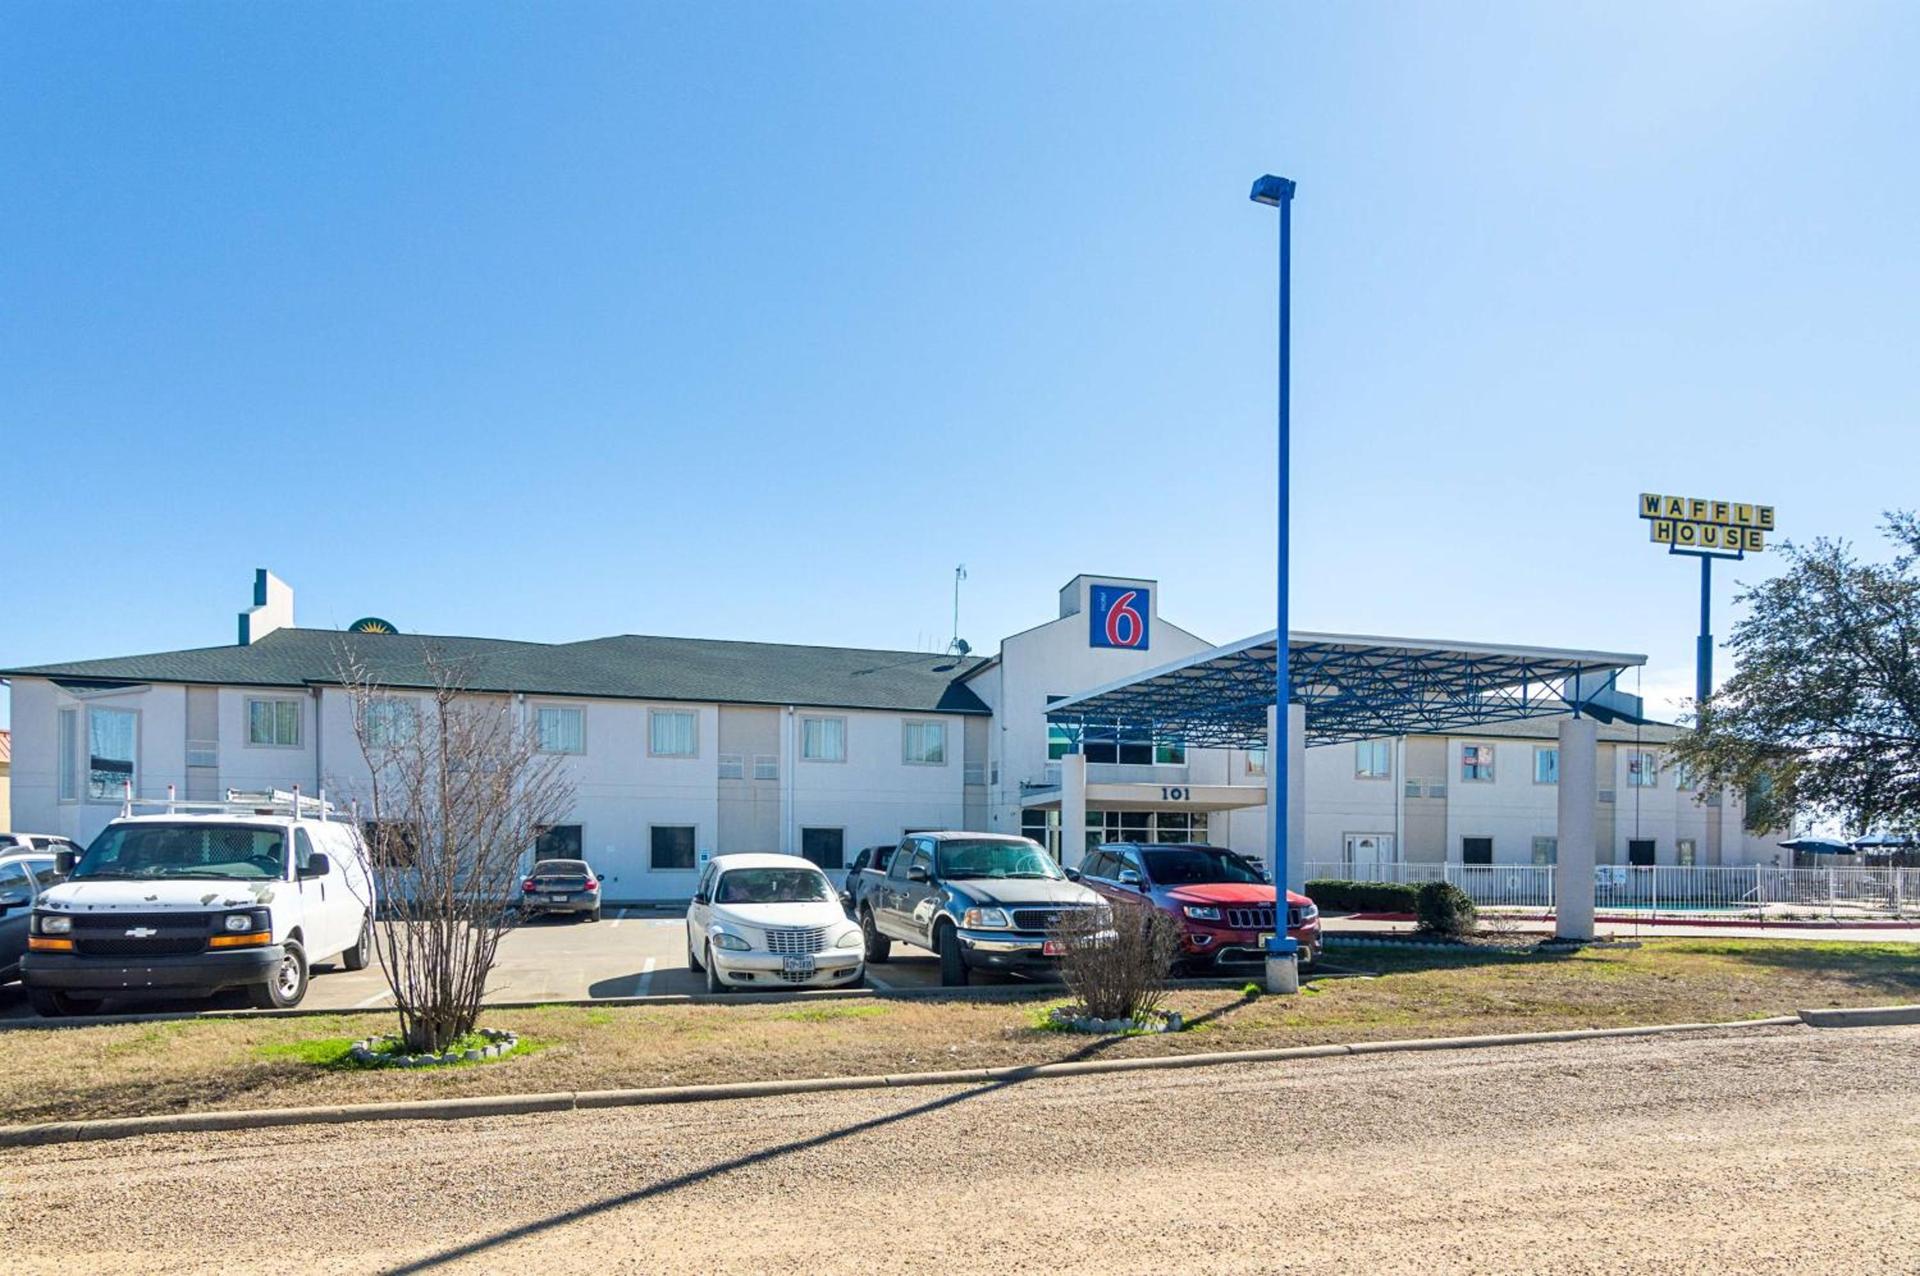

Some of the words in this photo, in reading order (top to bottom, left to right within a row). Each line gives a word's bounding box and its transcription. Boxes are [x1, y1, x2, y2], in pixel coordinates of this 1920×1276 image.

[1645, 495, 1772, 524] WAFFLE
[1657, 522, 1761, 547] HOUSE
[1105, 591, 1143, 646] 6
[1162, 787, 1190, 801] 101
